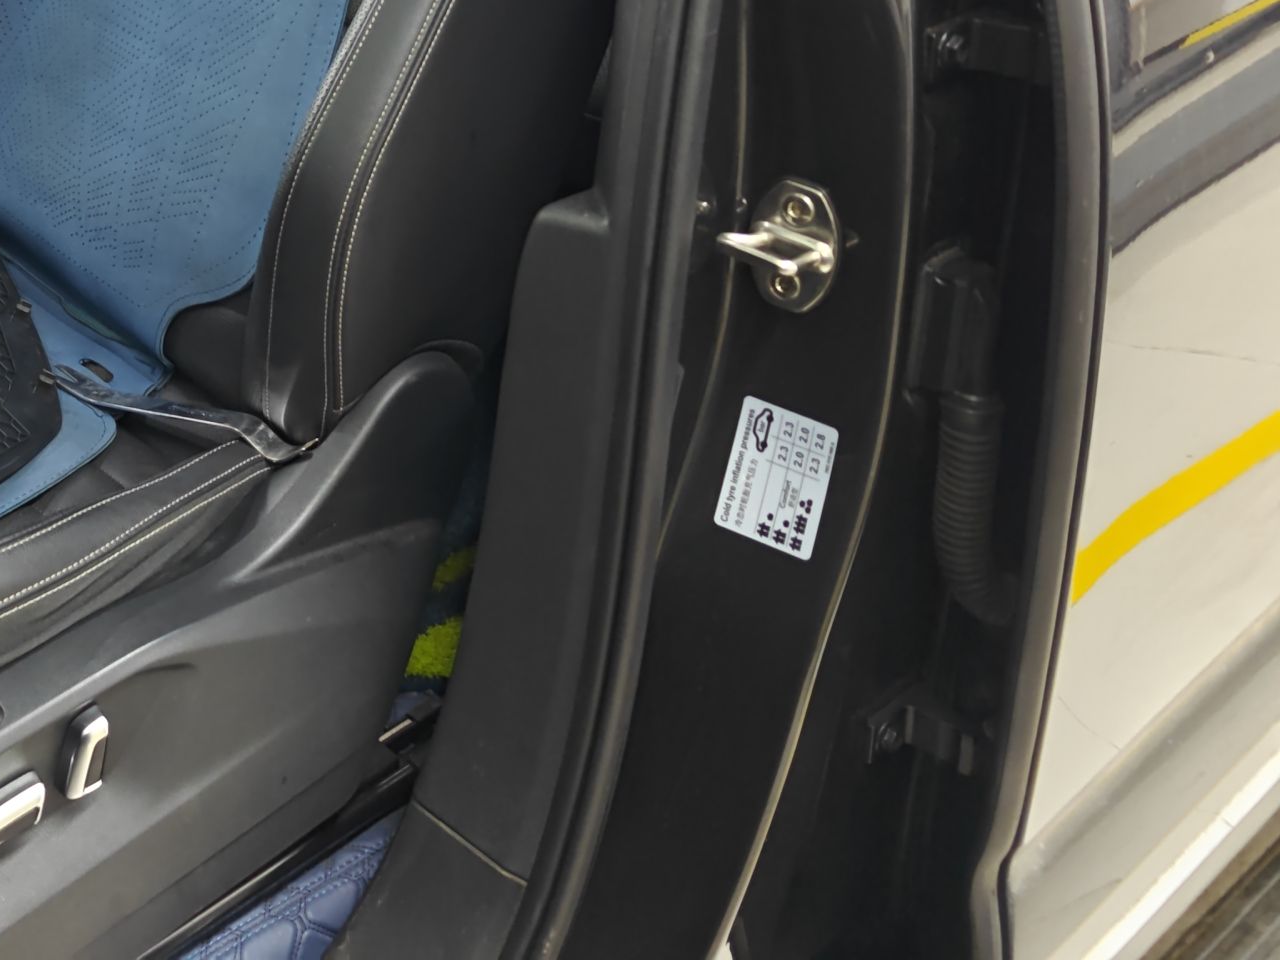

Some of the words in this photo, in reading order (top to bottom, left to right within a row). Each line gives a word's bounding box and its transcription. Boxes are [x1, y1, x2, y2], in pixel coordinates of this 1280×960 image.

[743, 409, 756, 450] pressures
[777, 445, 789, 463] 2.3
[783, 421, 795, 439] 2.3
[793, 451, 805, 469] 2.0
[799, 427, 811, 444] 2.0
[731, 451, 745, 483] inflation
[809, 458, 821, 474] 2.3
[727, 483, 737, 502] tyre
[720, 502, 732, 522] Cold
